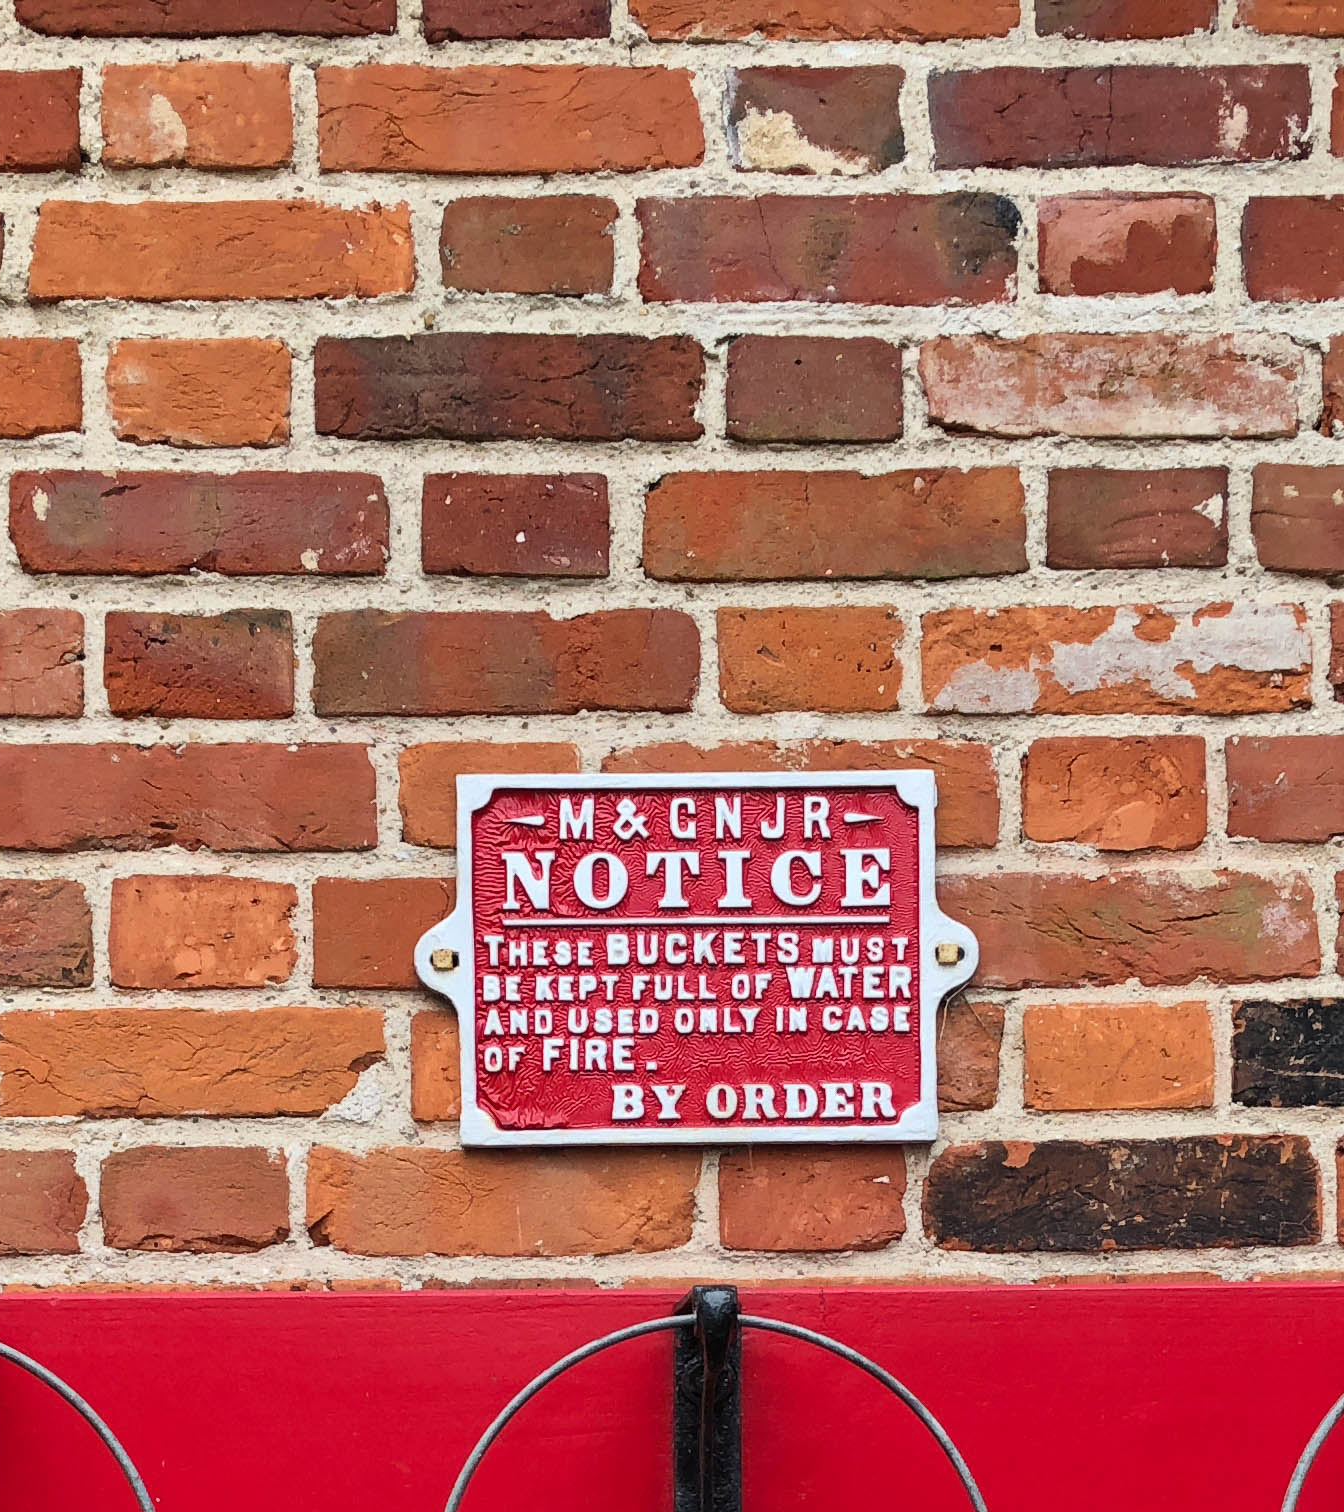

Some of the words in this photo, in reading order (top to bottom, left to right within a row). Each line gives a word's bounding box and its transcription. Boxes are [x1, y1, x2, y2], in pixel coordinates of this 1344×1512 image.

[501, 847, 891, 910] NOTICE
[483, 934, 594, 967] THESE
[605, 931, 800, 965] BUCKETS
[811, 936, 909, 965] MUST
[483, 974, 521, 1001] BE
[535, 974, 620, 1001] KEPT
[631, 974, 717, 1001] FULL
[731, 972, 773, 1000] OF
[785, 965, 913, 999] WATER
[483, 1007, 553, 1035] AND
[567, 1007, 660, 1034] USED
[673, 1006, 761, 1034] ONLY
[775, 1006, 808, 1032] IN
[822, 1005, 911, 1032] CASE
[484, 1045, 526, 1072] OF
[611, 1083, 686, 1120] BY
[705, 1081, 897, 1120] ORDER
